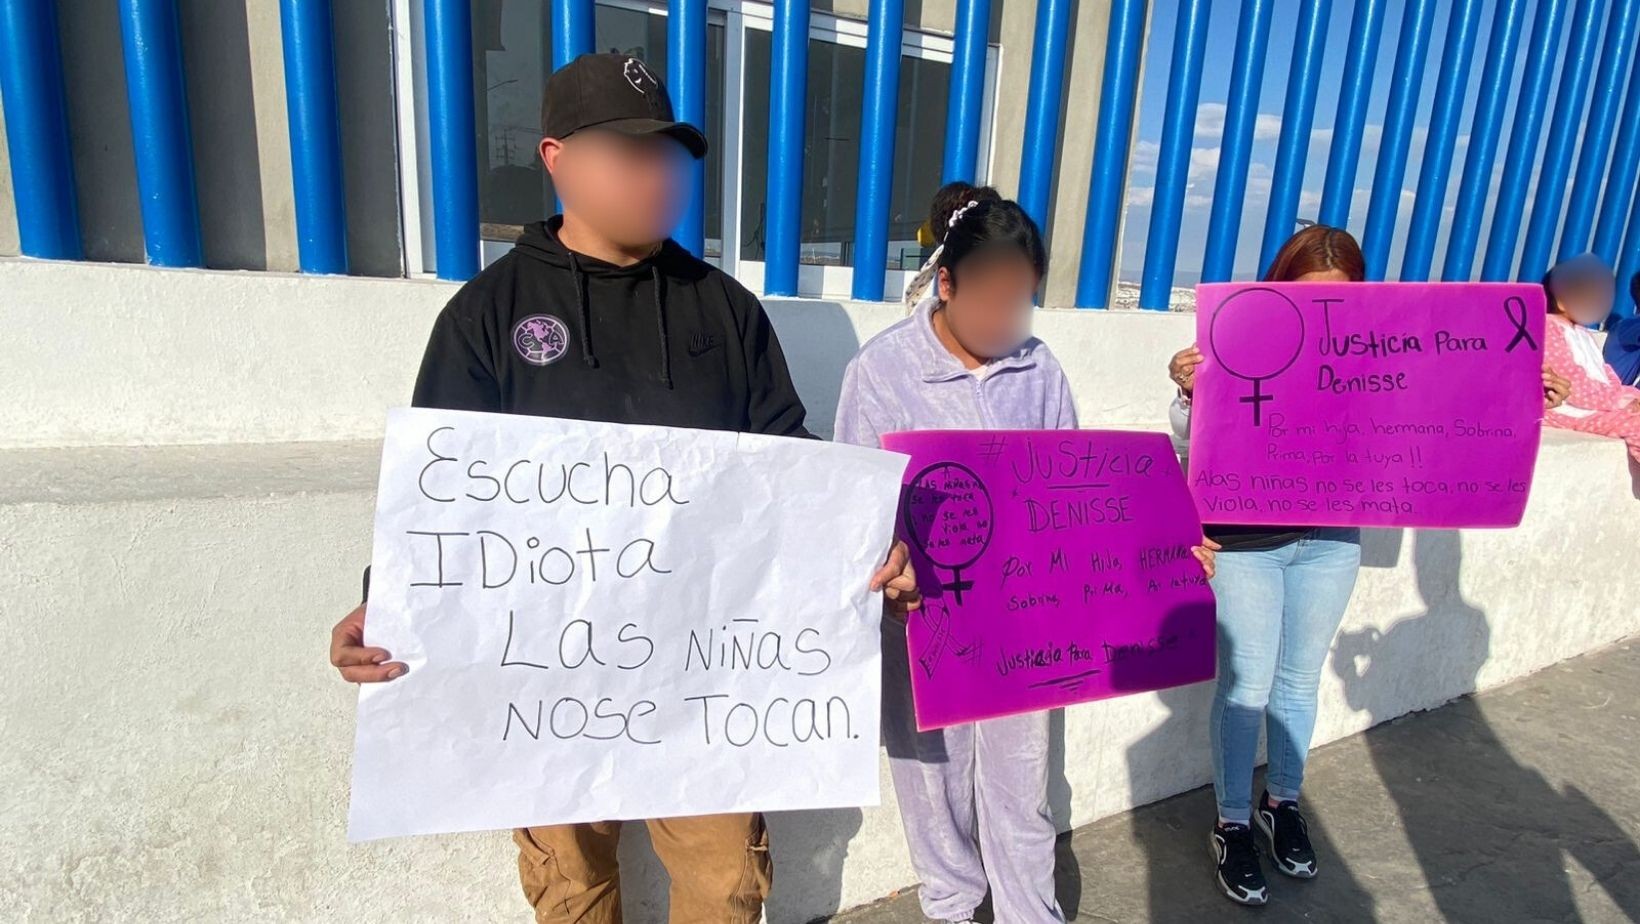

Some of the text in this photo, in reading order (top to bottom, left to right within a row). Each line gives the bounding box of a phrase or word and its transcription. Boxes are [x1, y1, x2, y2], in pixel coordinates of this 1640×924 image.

[1435, 330, 1488, 355] Para
[1316, 364, 1408, 395] Denisse
[1269, 413, 1289, 438] Por
[1296, 425, 1316, 436] mi
[418, 426, 690, 508] Escucha
[1345, 449, 1359, 463] la
[1251, 474, 1309, 492] niñas
[1316, 480, 1338, 493] no
[1344, 480, 1366, 493] se
[1371, 479, 1394, 492] les
[1457, 480, 1479, 493] no
[1486, 480, 1504, 492] se
[1507, 478, 1528, 493] les
[1025, 496, 1134, 533] DENISSE
[1268, 498, 1293, 512] no
[1298, 499, 1318, 512] se
[1327, 497, 1354, 512] les
